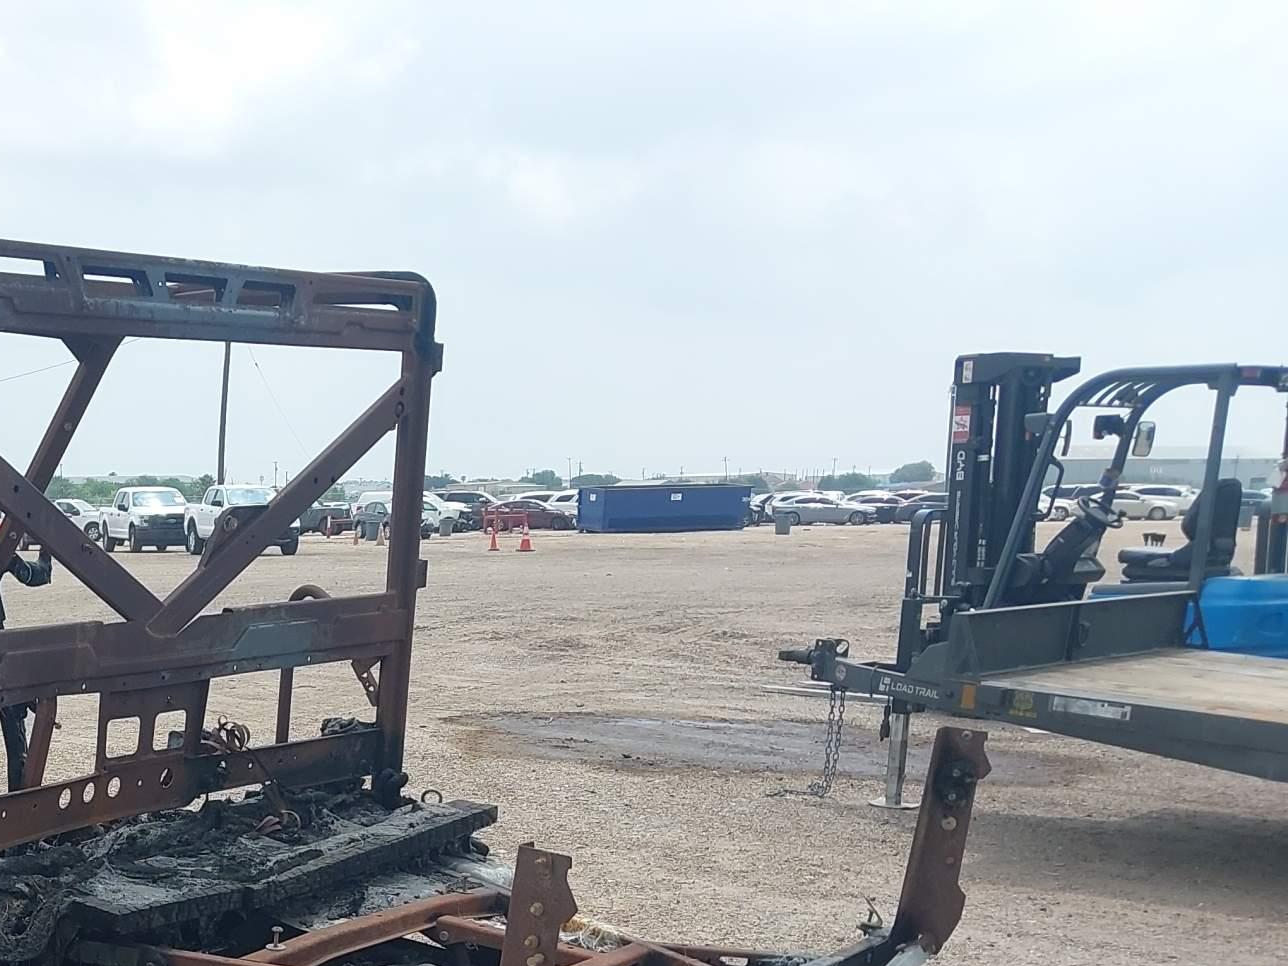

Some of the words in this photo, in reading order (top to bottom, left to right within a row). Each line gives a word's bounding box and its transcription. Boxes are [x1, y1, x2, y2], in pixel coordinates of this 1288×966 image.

[956, 450, 965, 480] BYD
[891, 681, 914, 694] LOAD
[915, 686, 940, 699] TRAIL
